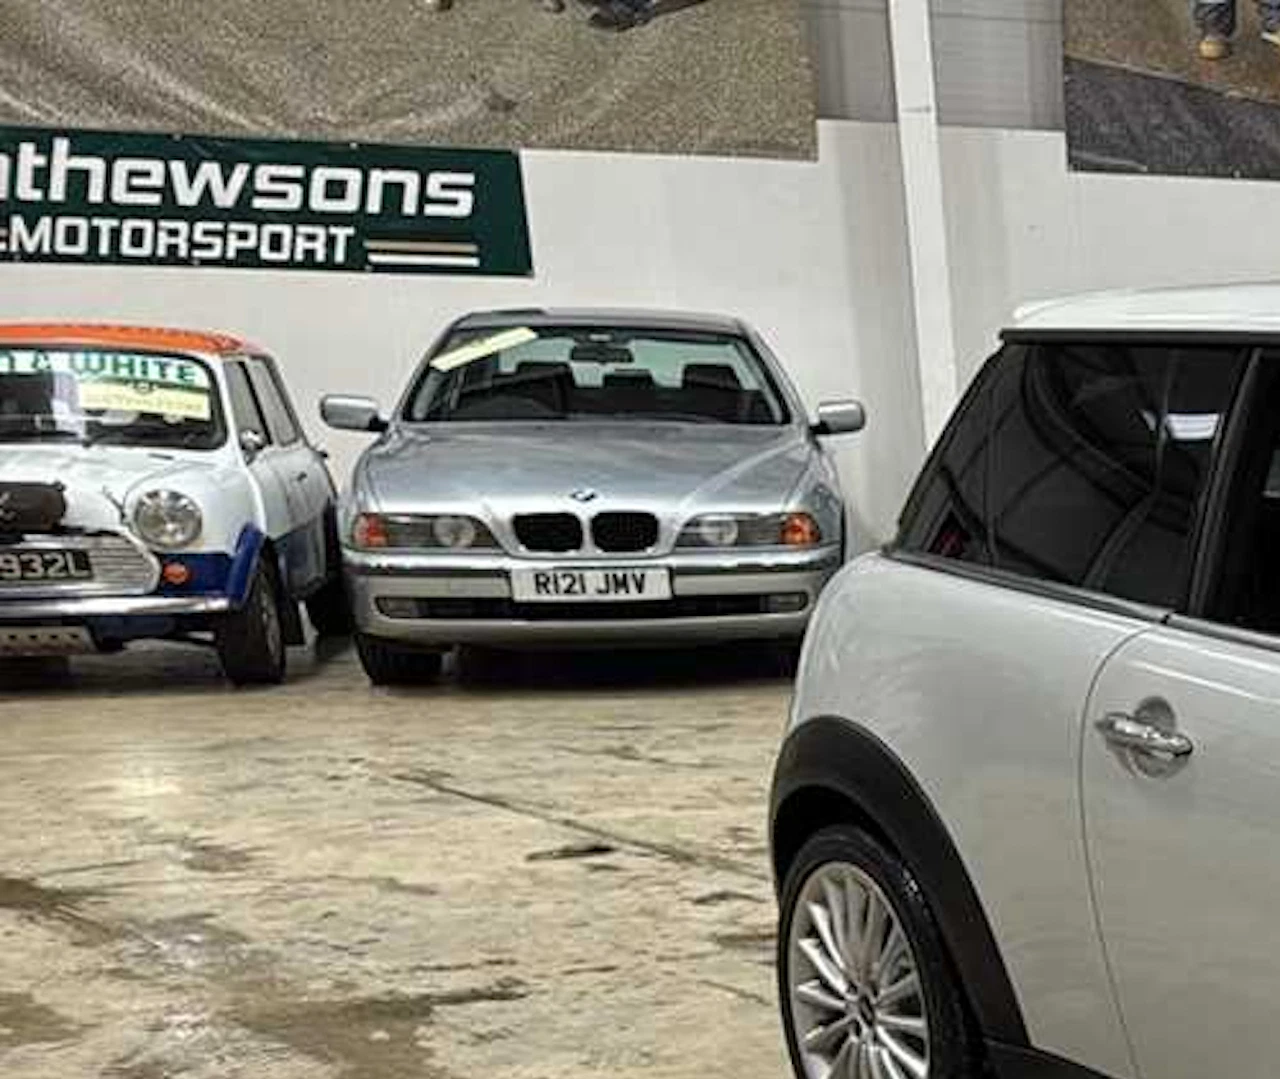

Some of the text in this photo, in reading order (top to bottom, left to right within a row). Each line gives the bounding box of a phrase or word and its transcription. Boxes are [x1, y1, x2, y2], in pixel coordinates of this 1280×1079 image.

[0, 137, 476, 217] thewsons
[8, 215, 354, 264] MOTORSPORT
[70, 350, 197, 381] WHITE
[534, 572, 646, 594] R121 JMV
